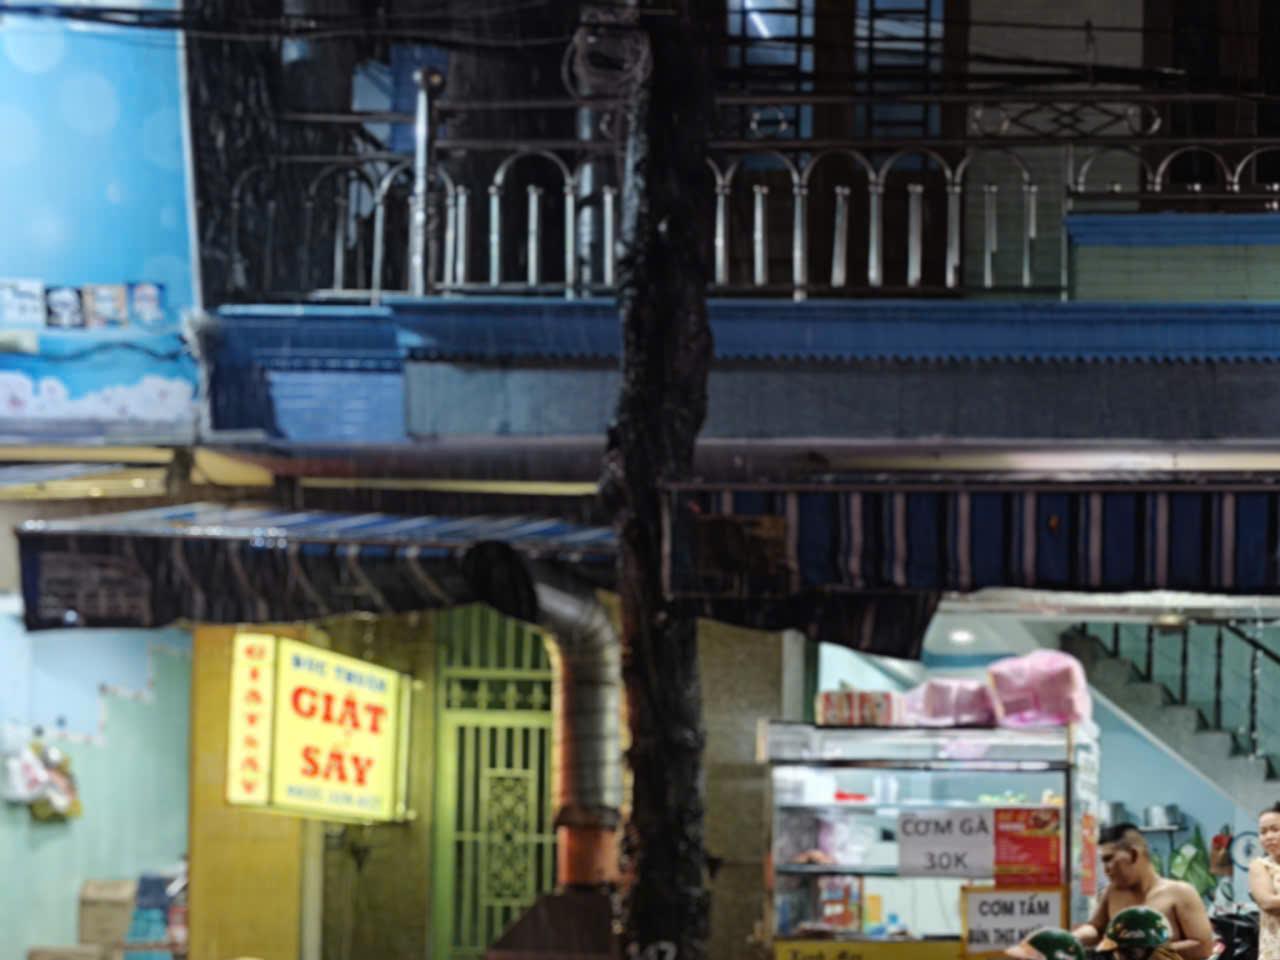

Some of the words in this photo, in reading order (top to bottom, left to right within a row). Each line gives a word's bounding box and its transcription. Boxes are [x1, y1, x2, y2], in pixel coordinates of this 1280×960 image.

[901, 818, 953, 837] CƠM
[959, 815, 990, 836] GÀ
[923, 851, 969, 871] 30K
